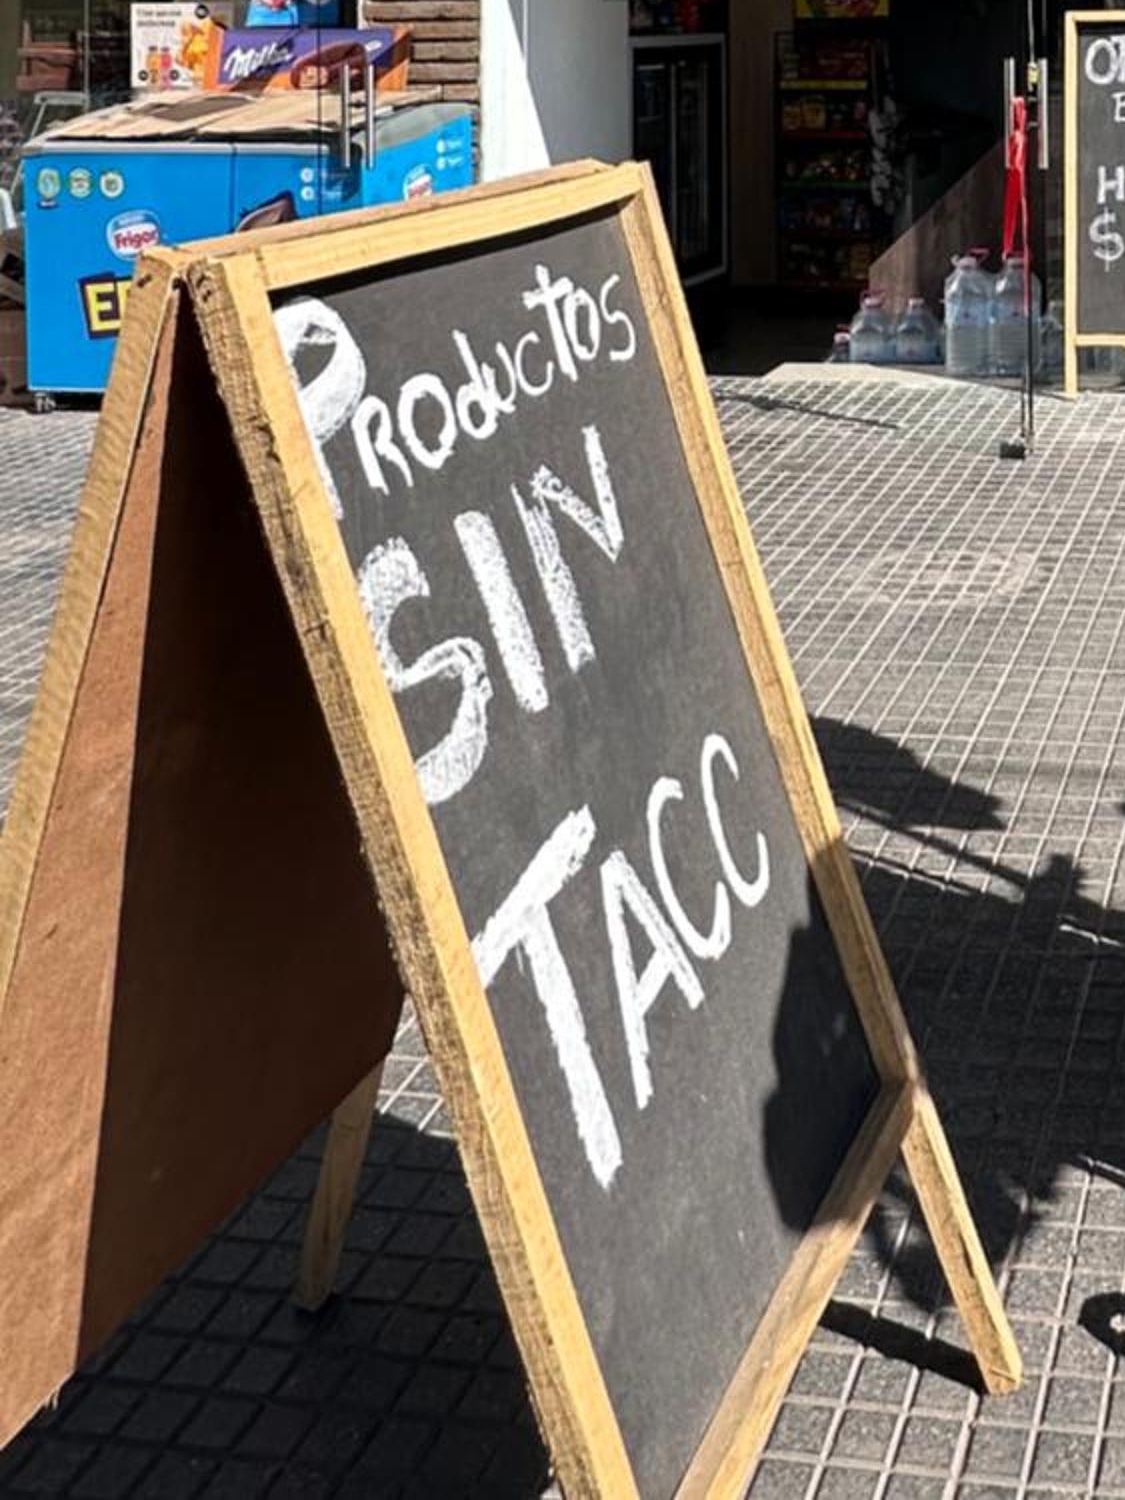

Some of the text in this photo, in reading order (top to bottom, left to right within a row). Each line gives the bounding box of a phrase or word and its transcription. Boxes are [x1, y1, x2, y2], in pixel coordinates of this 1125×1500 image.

[224, 40, 293, 81] Milka
[114, 228, 158, 250] Frigor
[359, 425, 624, 805] SIN
[471, 732, 770, 1190] TACC
